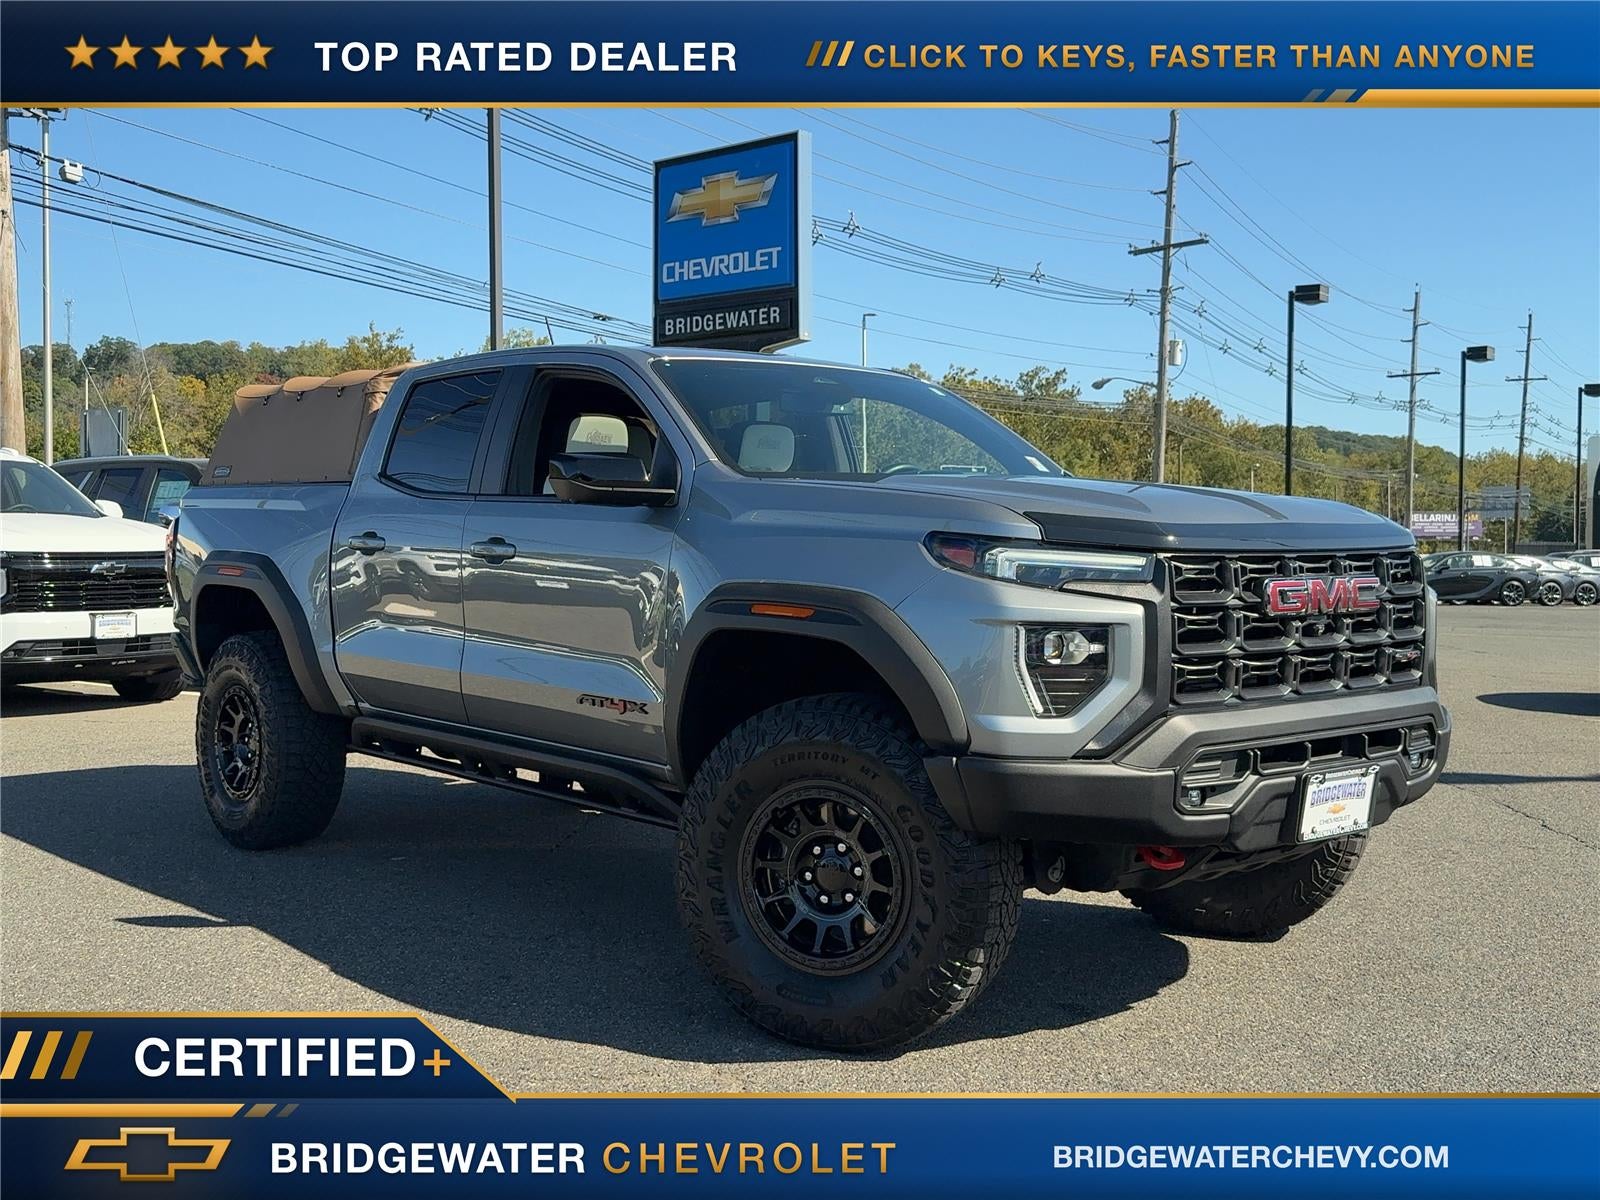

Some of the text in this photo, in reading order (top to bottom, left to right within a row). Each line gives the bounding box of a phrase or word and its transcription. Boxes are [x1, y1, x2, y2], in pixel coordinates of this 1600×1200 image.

[662, 246, 782, 284] CHEVROLET
[664, 306, 781, 336] BRIDGEWATER
[1266, 576, 1381, 616] GMC
[576, 693, 649, 715] AT4X
[772, 750, 850, 768] TERRITORY
[1310, 781, 1367, 808] BRIDGEWATER
[705, 780, 754, 944] WRANGLER
